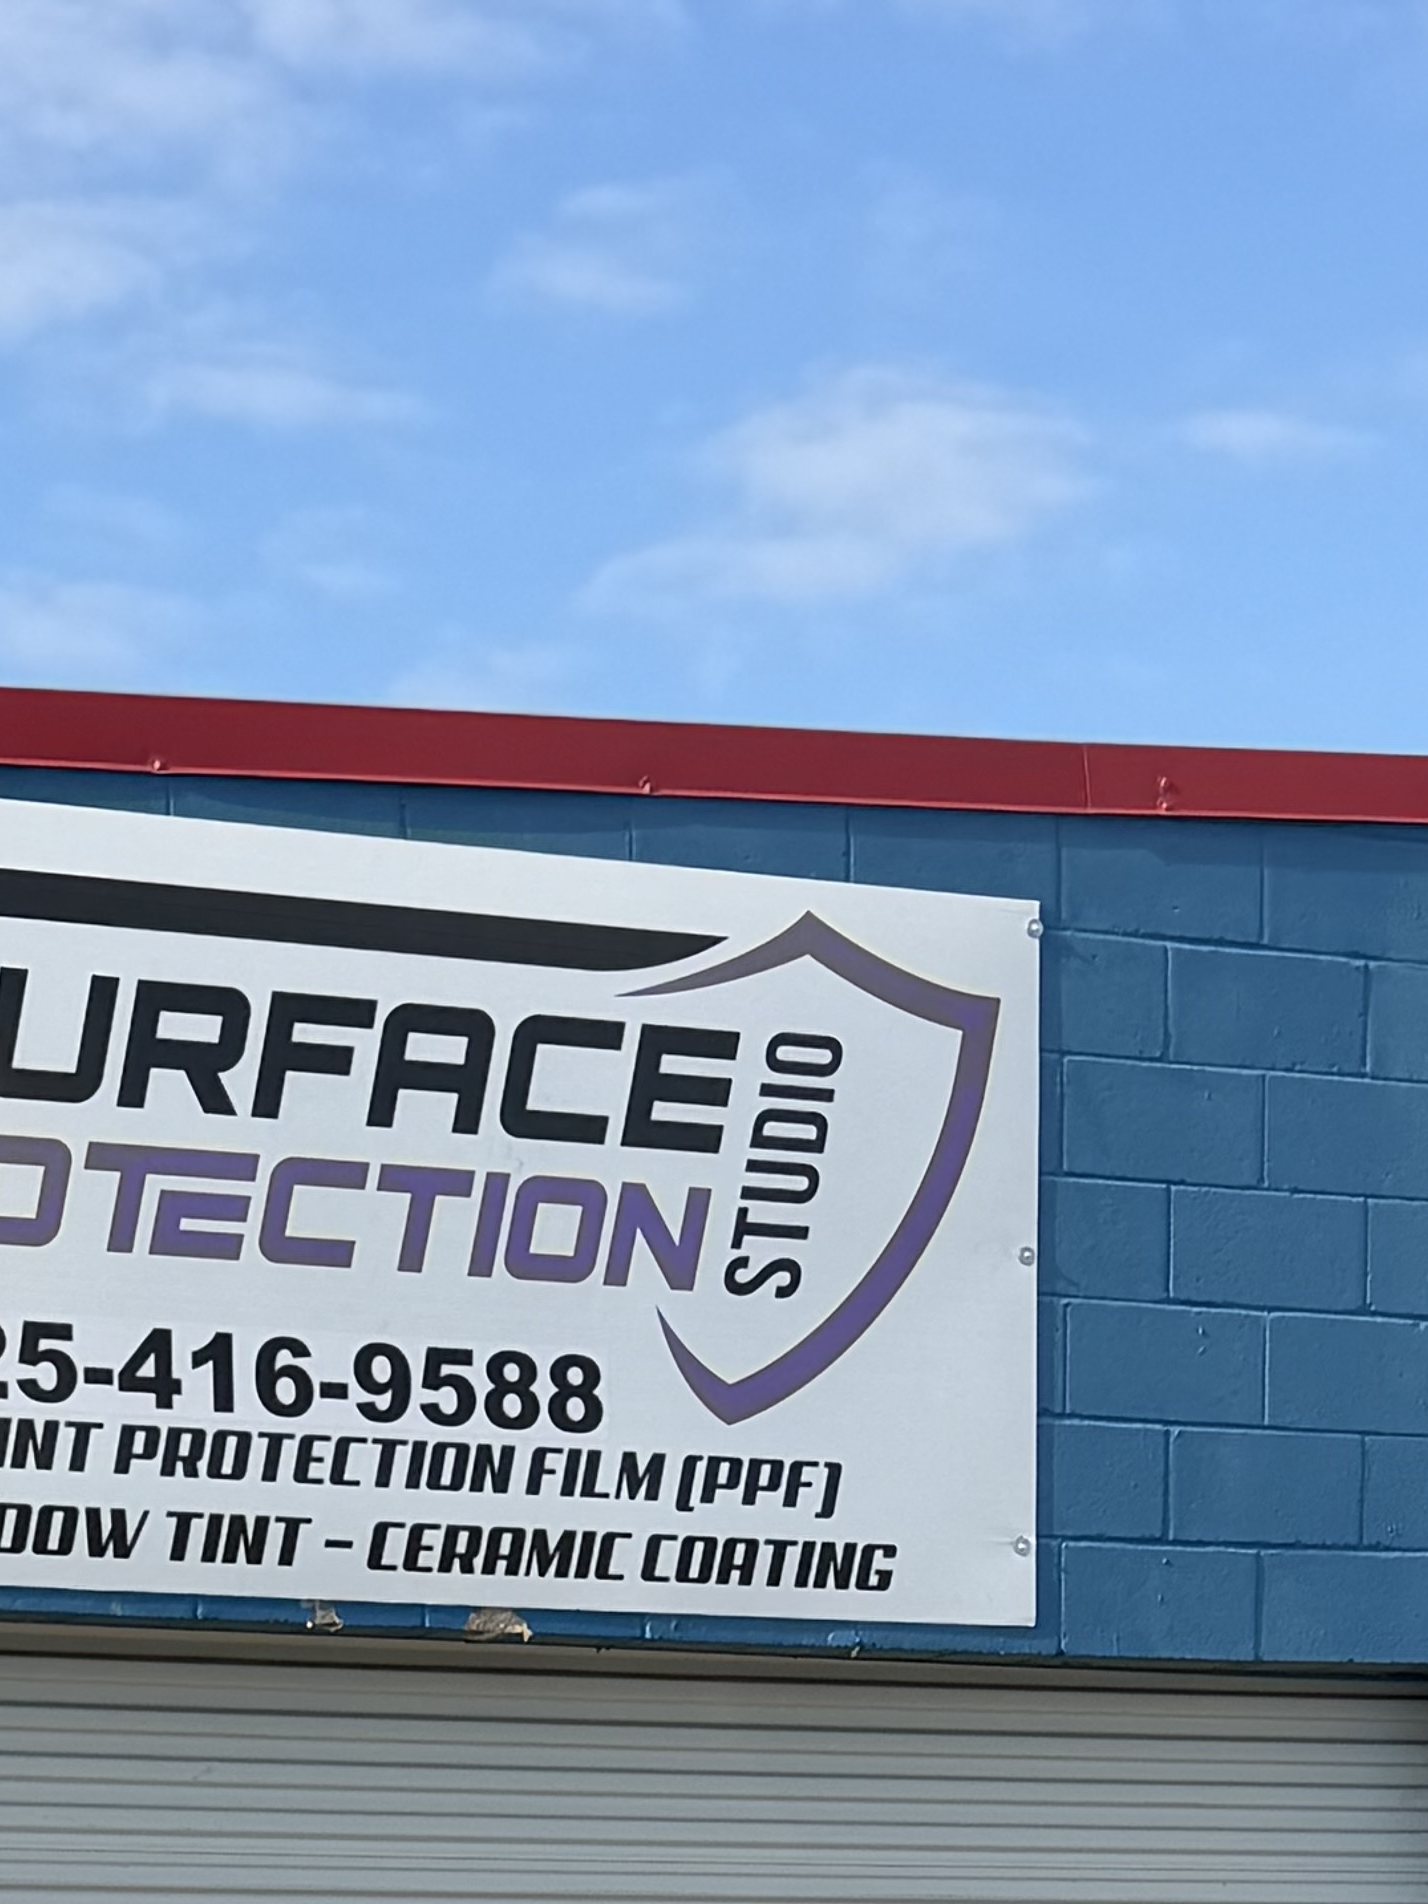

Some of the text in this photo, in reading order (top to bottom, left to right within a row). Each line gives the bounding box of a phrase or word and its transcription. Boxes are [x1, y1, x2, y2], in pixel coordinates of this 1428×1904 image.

[725, 1033, 842, 1298] STUDIO
[114, 1425, 515, 1493] PROTECTION
[526, 1447, 665, 1500] FILM
[167, 1512, 312, 1566] TINT
[325, 1540, 353, 1548] -
[367, 1522, 632, 1580] CERAMIC
[641, 1534, 896, 1591] COATING
